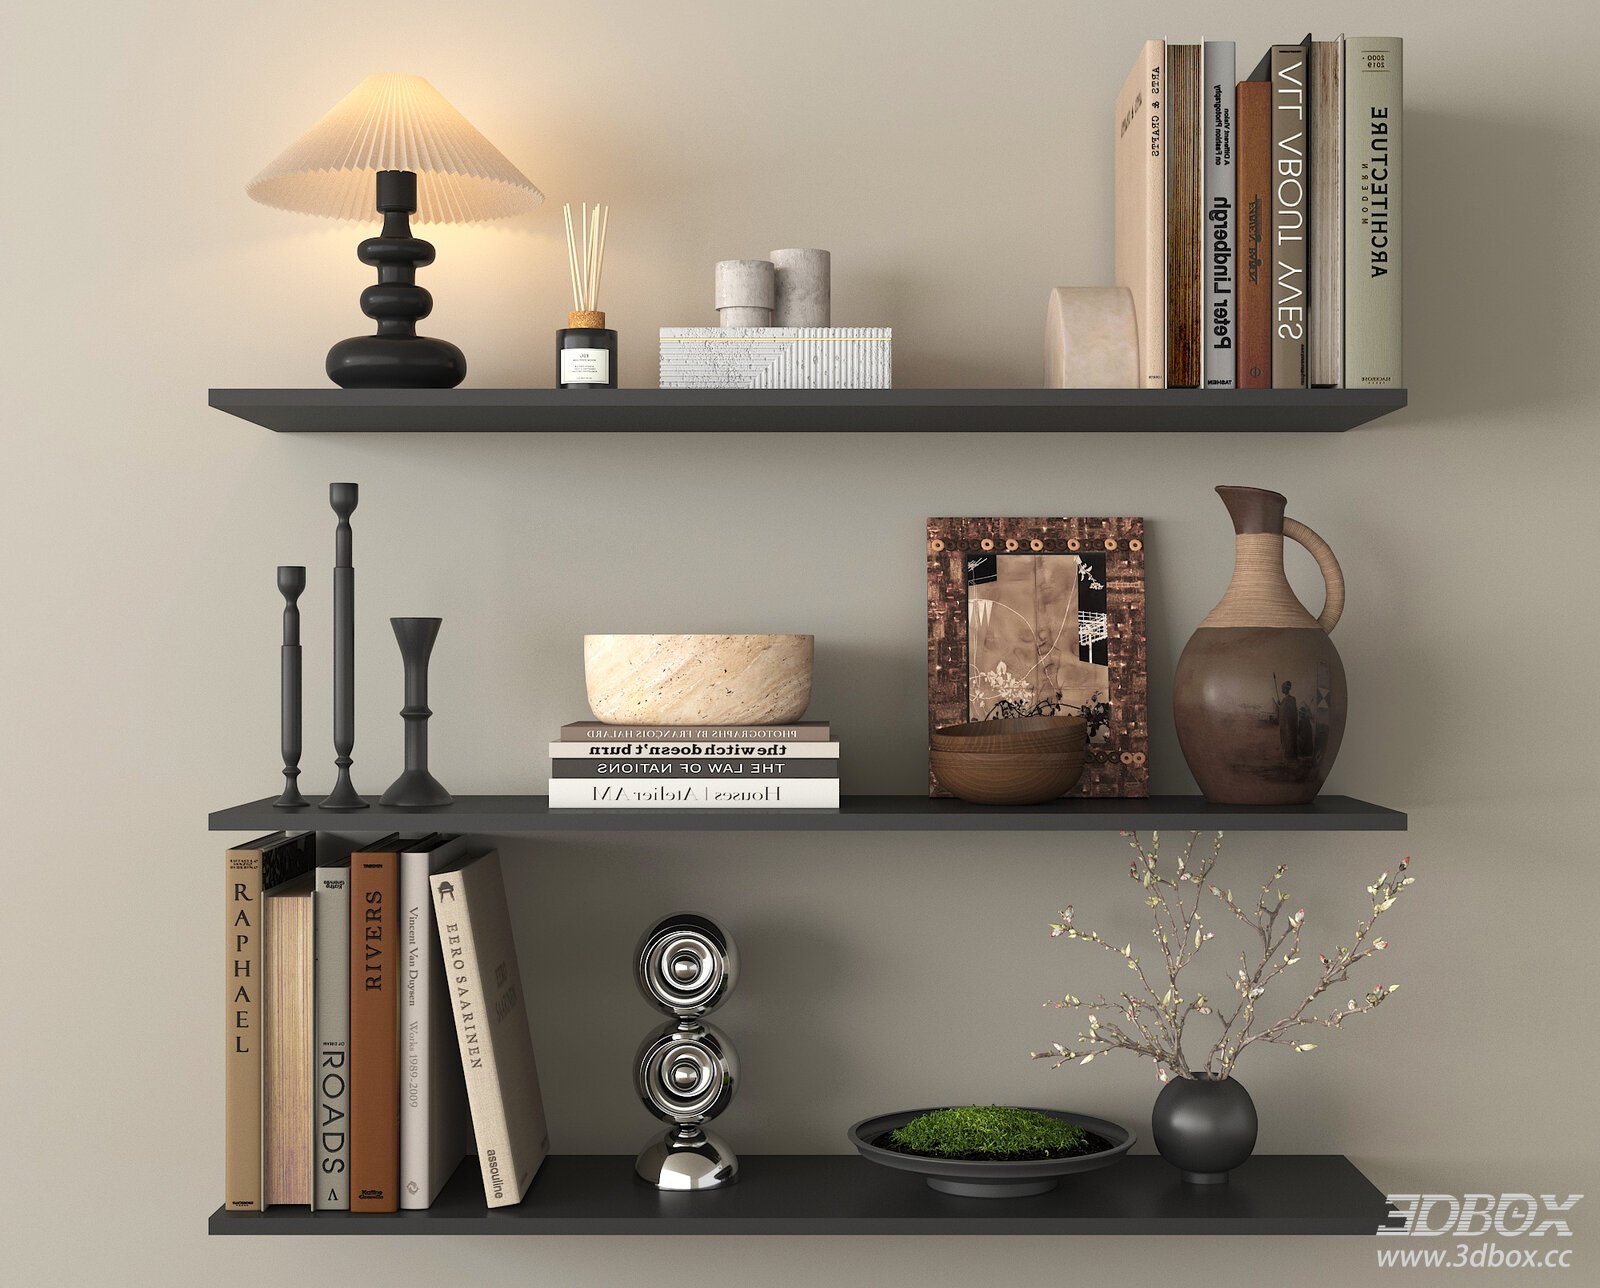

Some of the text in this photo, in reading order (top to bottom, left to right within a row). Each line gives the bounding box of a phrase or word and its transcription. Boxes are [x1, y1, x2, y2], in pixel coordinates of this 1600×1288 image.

[365, 890, 382, 991] RIVERS
[409, 906, 419, 945] Vincent
[234, 883, 253, 1053] RAPHAEL
[409, 947, 419, 967] Van
[407, 969, 419, 1007] Duysen
[446, 922, 483, 1069] EERO SAARINEN
[408, 1021, 419, 1051] Works
[322, 1051, 345, 1174] ROADS
[487, 1149, 504, 1200] assouline
